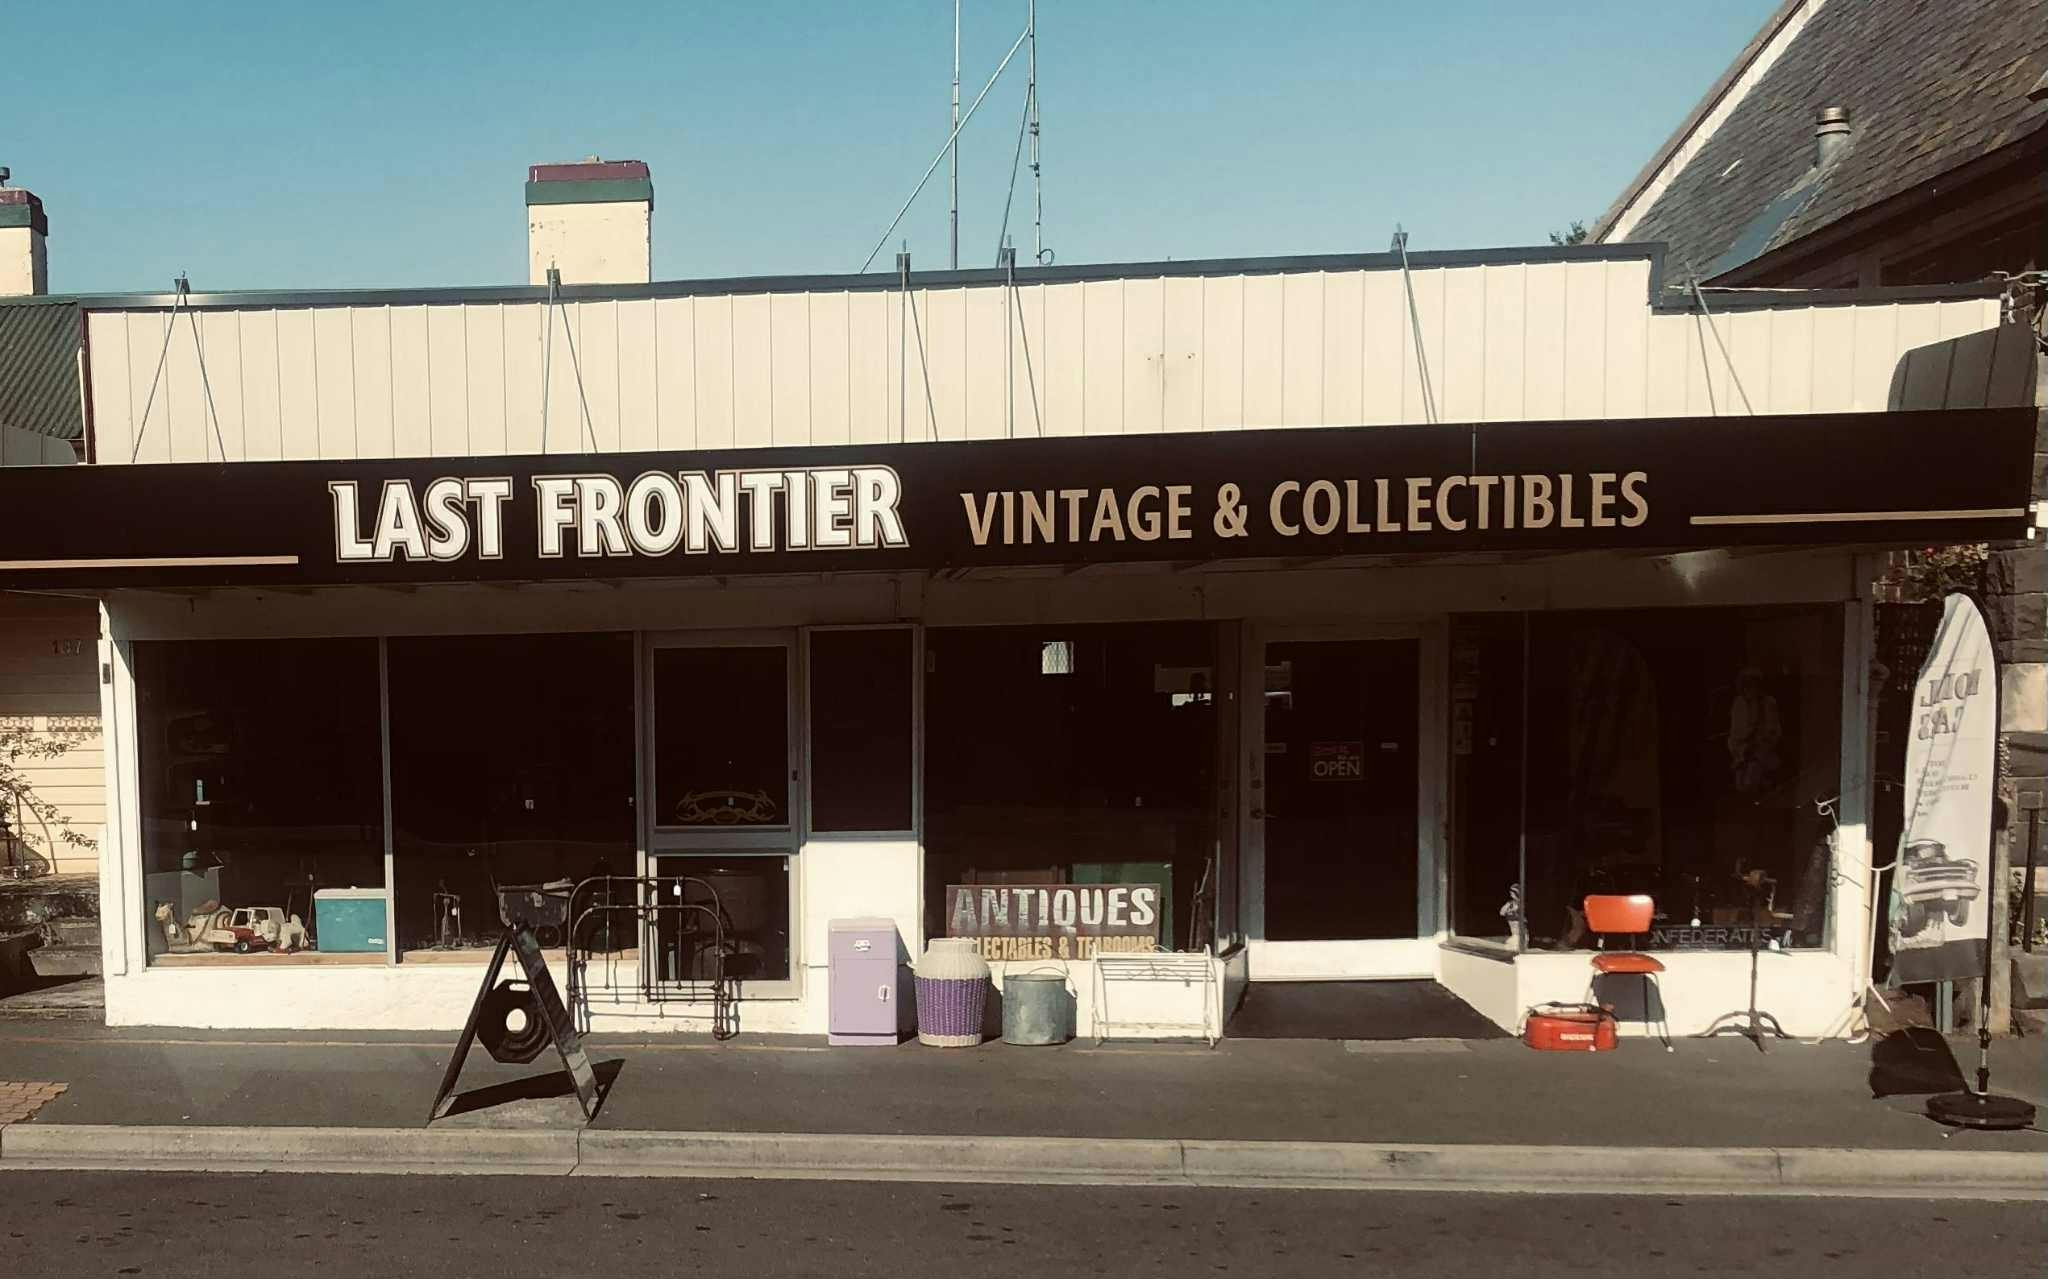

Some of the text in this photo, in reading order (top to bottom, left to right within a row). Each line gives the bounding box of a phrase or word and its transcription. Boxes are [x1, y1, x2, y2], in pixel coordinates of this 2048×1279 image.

[328, 464, 1649, 563] LAST FRONTIER VINTAGE & COLLECTIBLES
[1314, 760, 1361, 776] OPEN
[950, 887, 1156, 933] ANTIQUES
[1649, 927, 1772, 944] NFEDERATS
[956, 936, 1053, 960] LECTABLES
[1058, 936, 1070, 960] &
